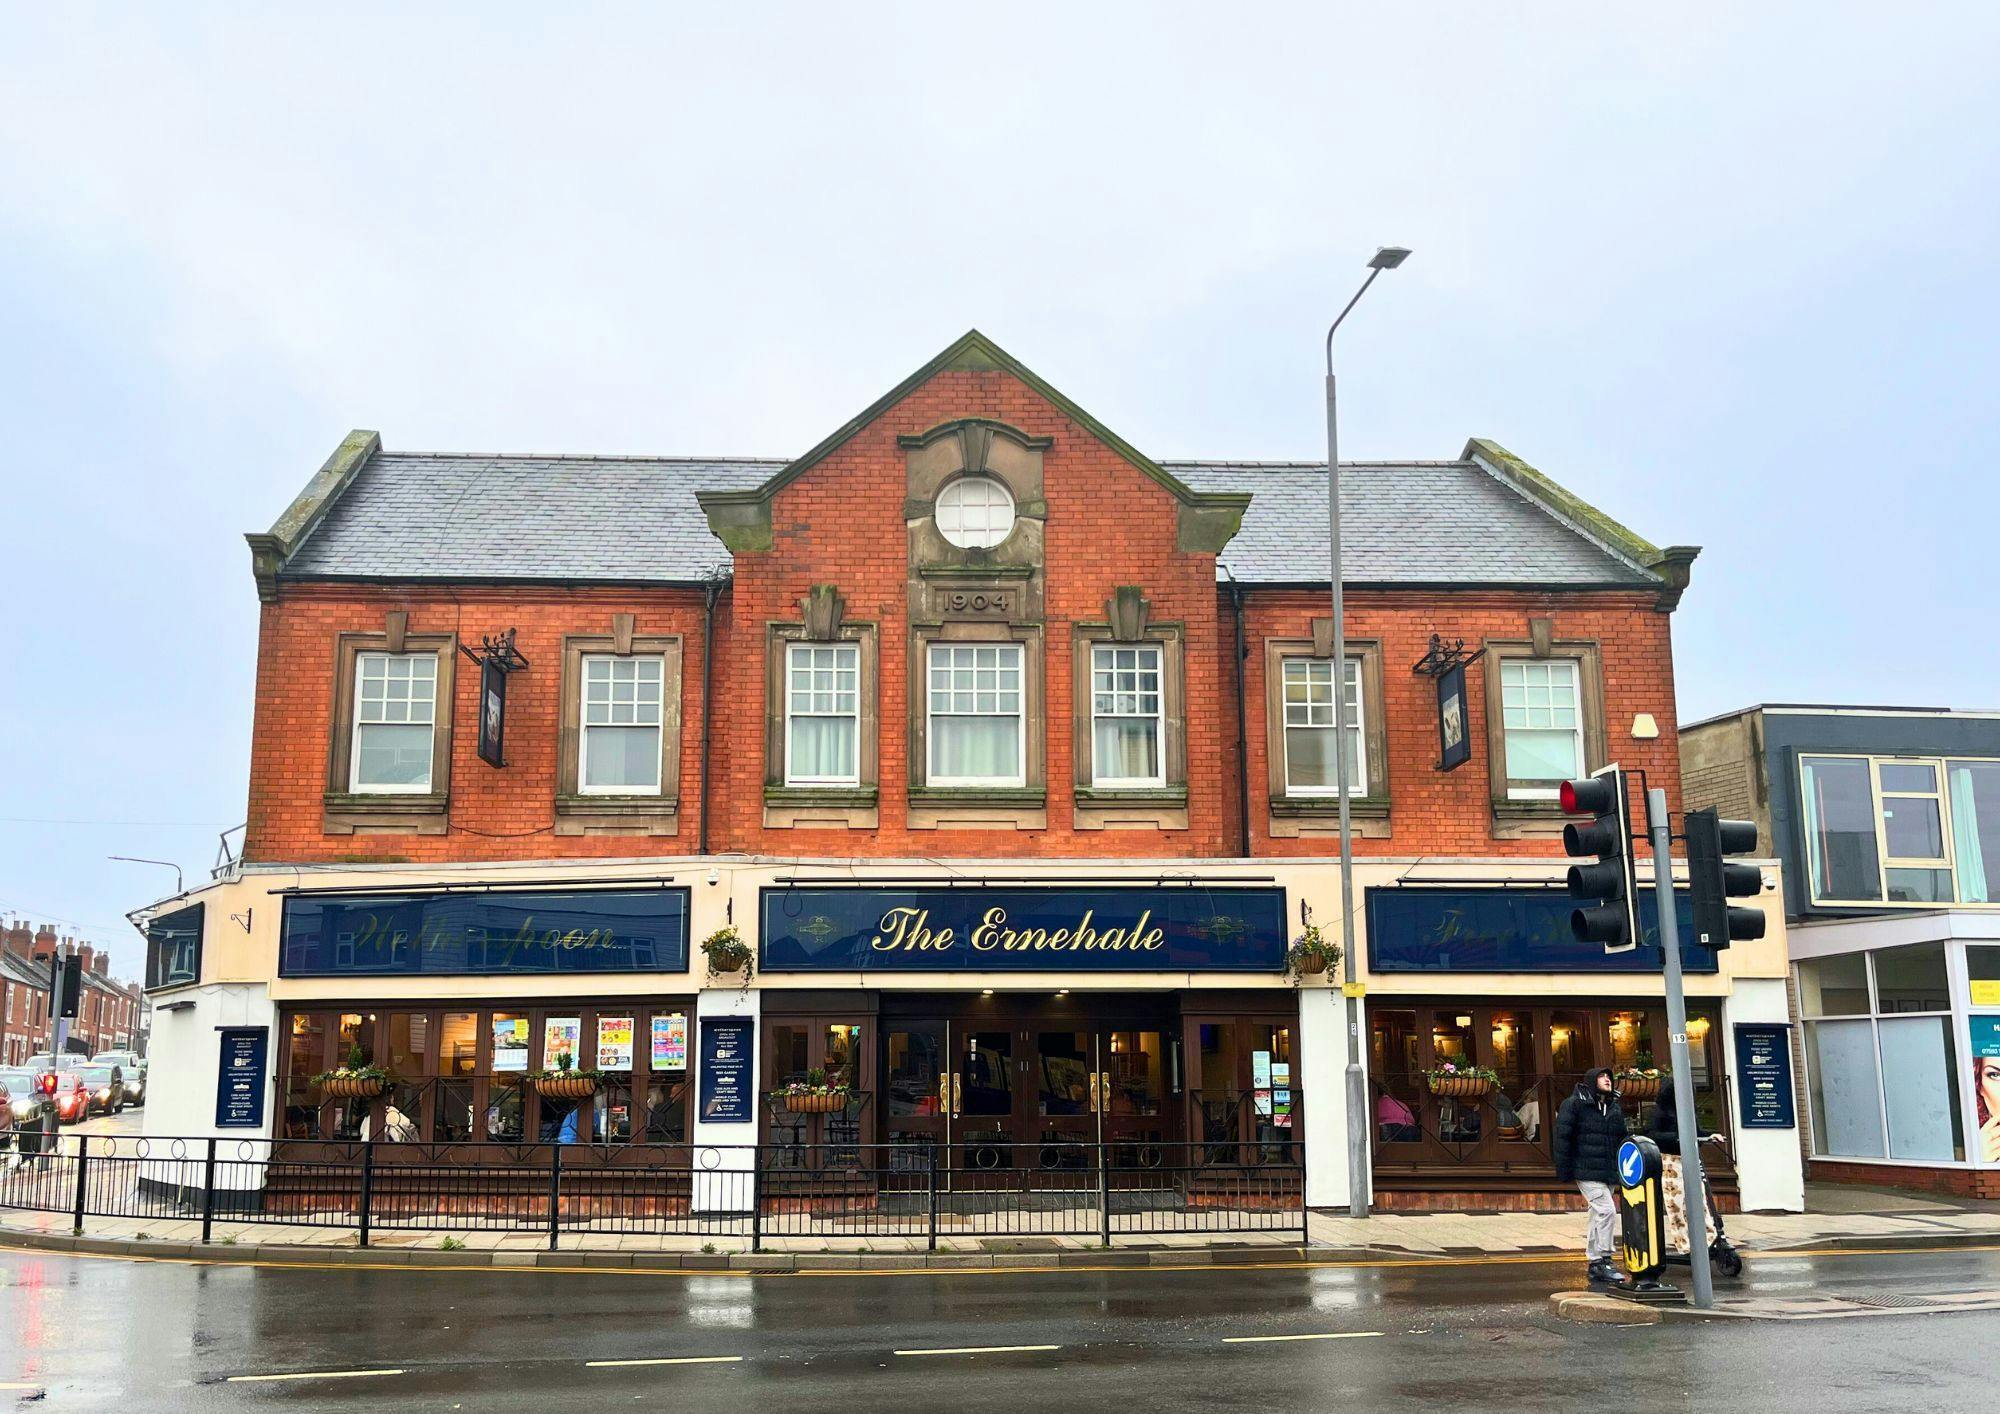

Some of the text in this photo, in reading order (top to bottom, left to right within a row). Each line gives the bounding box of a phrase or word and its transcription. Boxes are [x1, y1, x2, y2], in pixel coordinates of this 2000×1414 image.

[944, 592, 1009, 611] 1904
[353, 913, 617, 968] Wethpoon
[871, 907, 1165, 950] The Ernehale
